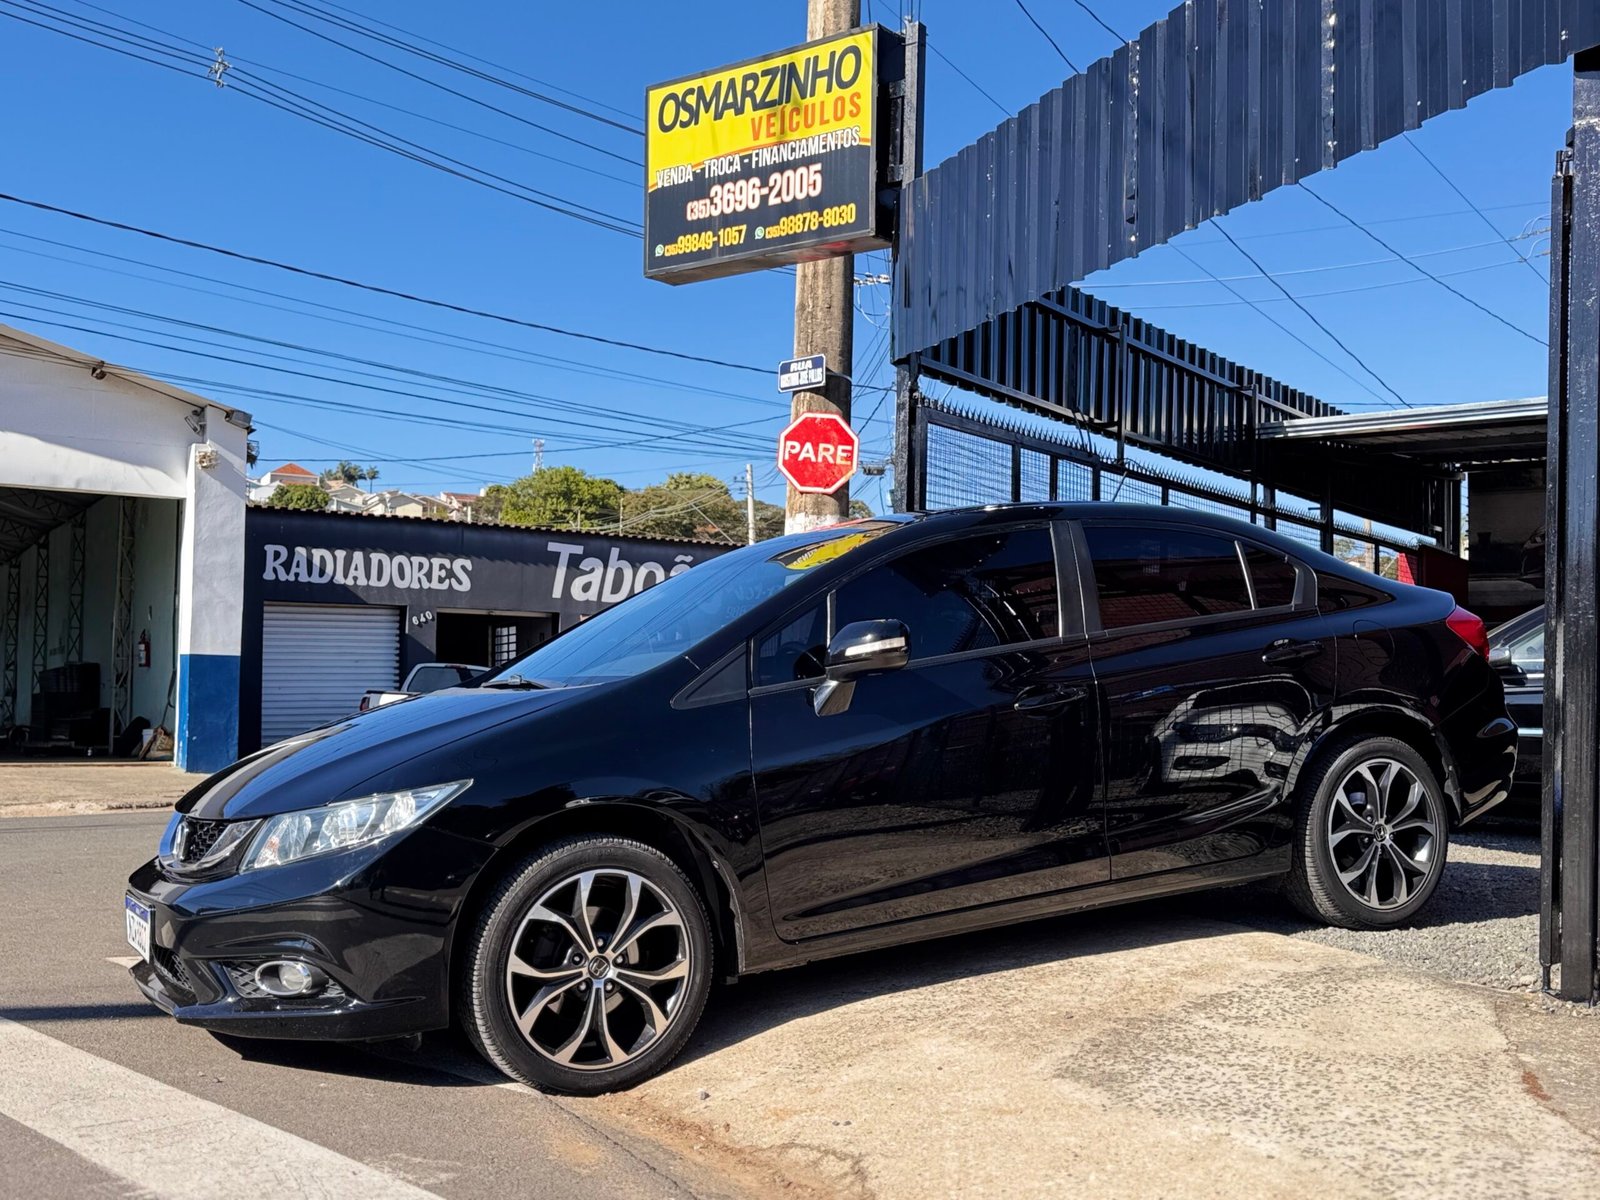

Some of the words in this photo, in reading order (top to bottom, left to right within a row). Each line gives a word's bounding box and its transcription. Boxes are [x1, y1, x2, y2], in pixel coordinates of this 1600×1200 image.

[658, 45, 862, 133] OSMARZINHO
[751, 91, 861, 141] VEÍCULOS
[656, 163, 694, 189] VENDA
[704, 154, 741, 179] TROCA
[751, 126, 861, 169] FINANCIAMENTOS
[790, 359, 813, 373] RUA
[784, 440, 853, 466] PARE
[262, 544, 473, 592] RADIADORES
[412, 610, 433, 625] 640
